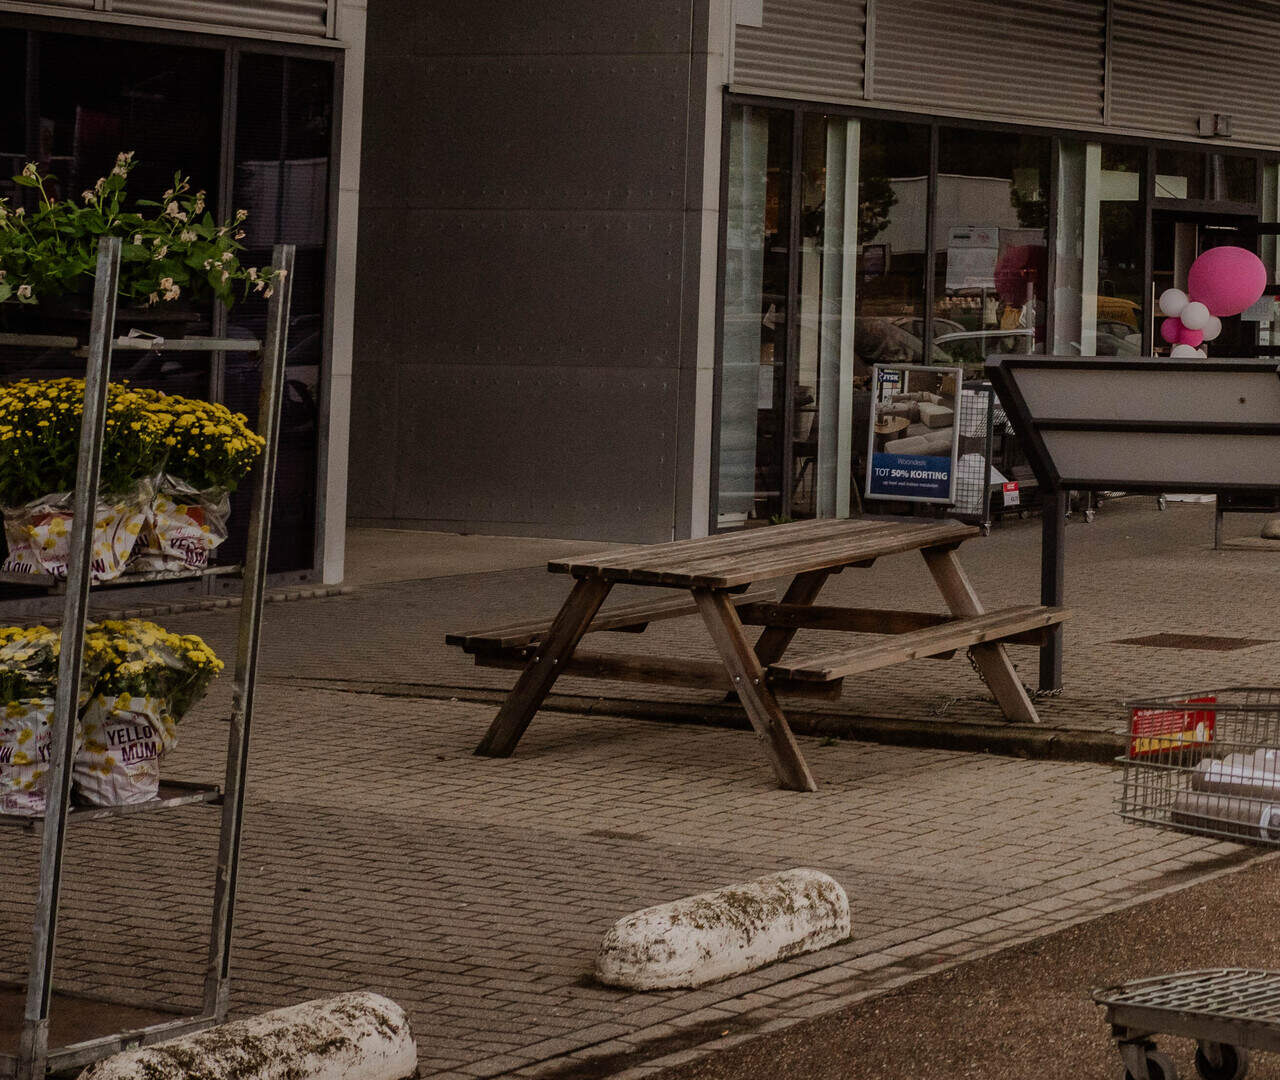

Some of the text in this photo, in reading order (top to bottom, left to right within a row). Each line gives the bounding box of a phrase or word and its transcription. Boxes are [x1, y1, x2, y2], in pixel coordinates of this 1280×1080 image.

[882, 373, 899, 381] JYSK
[874, 468, 948, 480] TOT 50% KORTING
[121, 741, 157, 762] MUM
